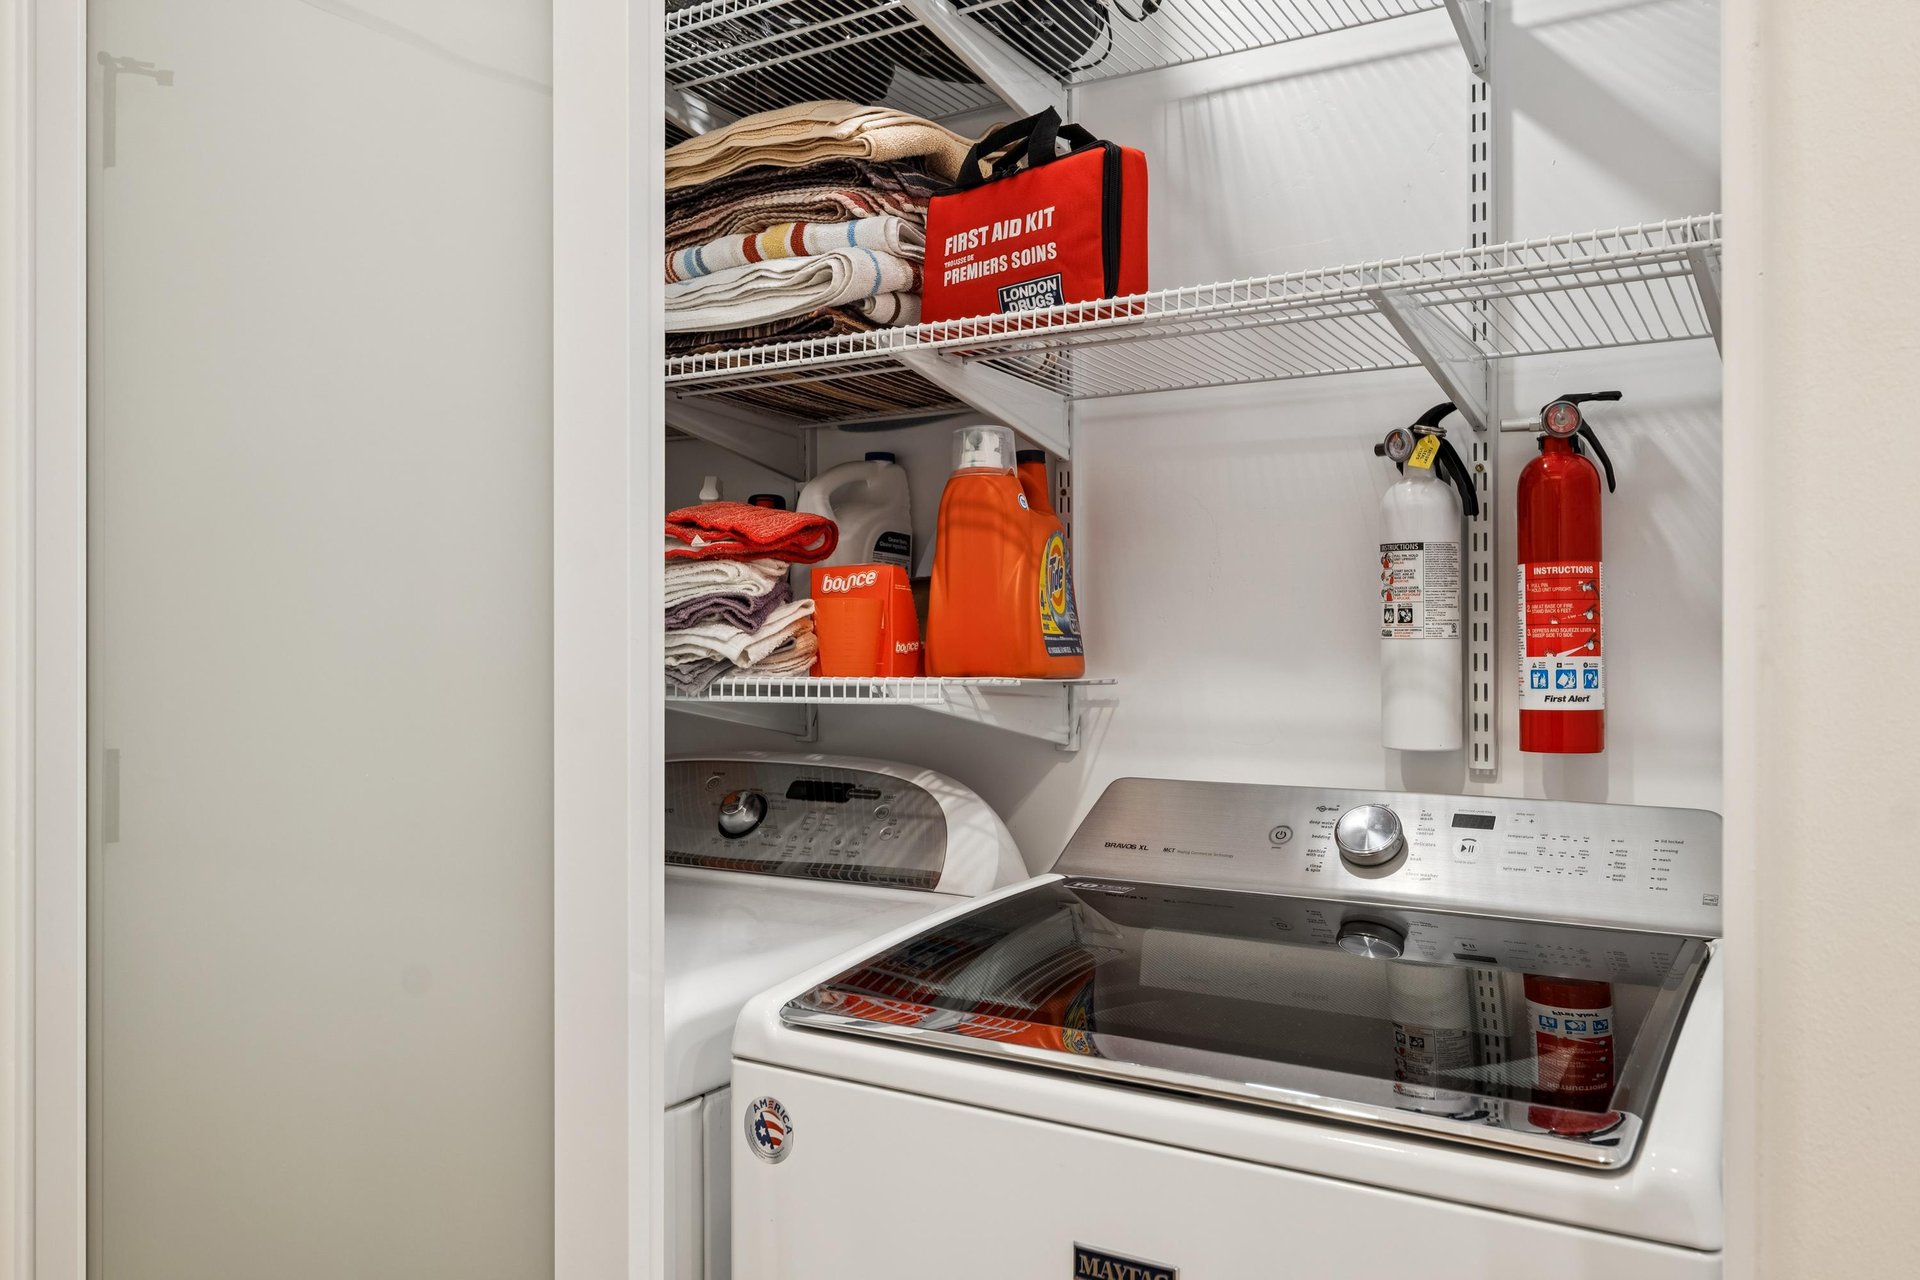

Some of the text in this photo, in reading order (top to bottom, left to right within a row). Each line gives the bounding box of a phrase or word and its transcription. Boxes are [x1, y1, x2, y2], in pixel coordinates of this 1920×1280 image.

[944, 206, 1055, 256] FIRST AID KIT
[944, 256, 967, 268] TROUSSE
[944, 242, 1057, 287] PREMIERS SOINS
[1003, 278, 1056, 302] LONDON
[1009, 293, 1054, 313] DRUGS
[1049, 554, 1063, 595] Tide
[1534, 566, 1593, 574] INSTRUCTIONS
[822, 571, 877, 592] bounce
[896, 641, 919, 654] bounce
[753, 1098, 792, 1134] AMERICA
